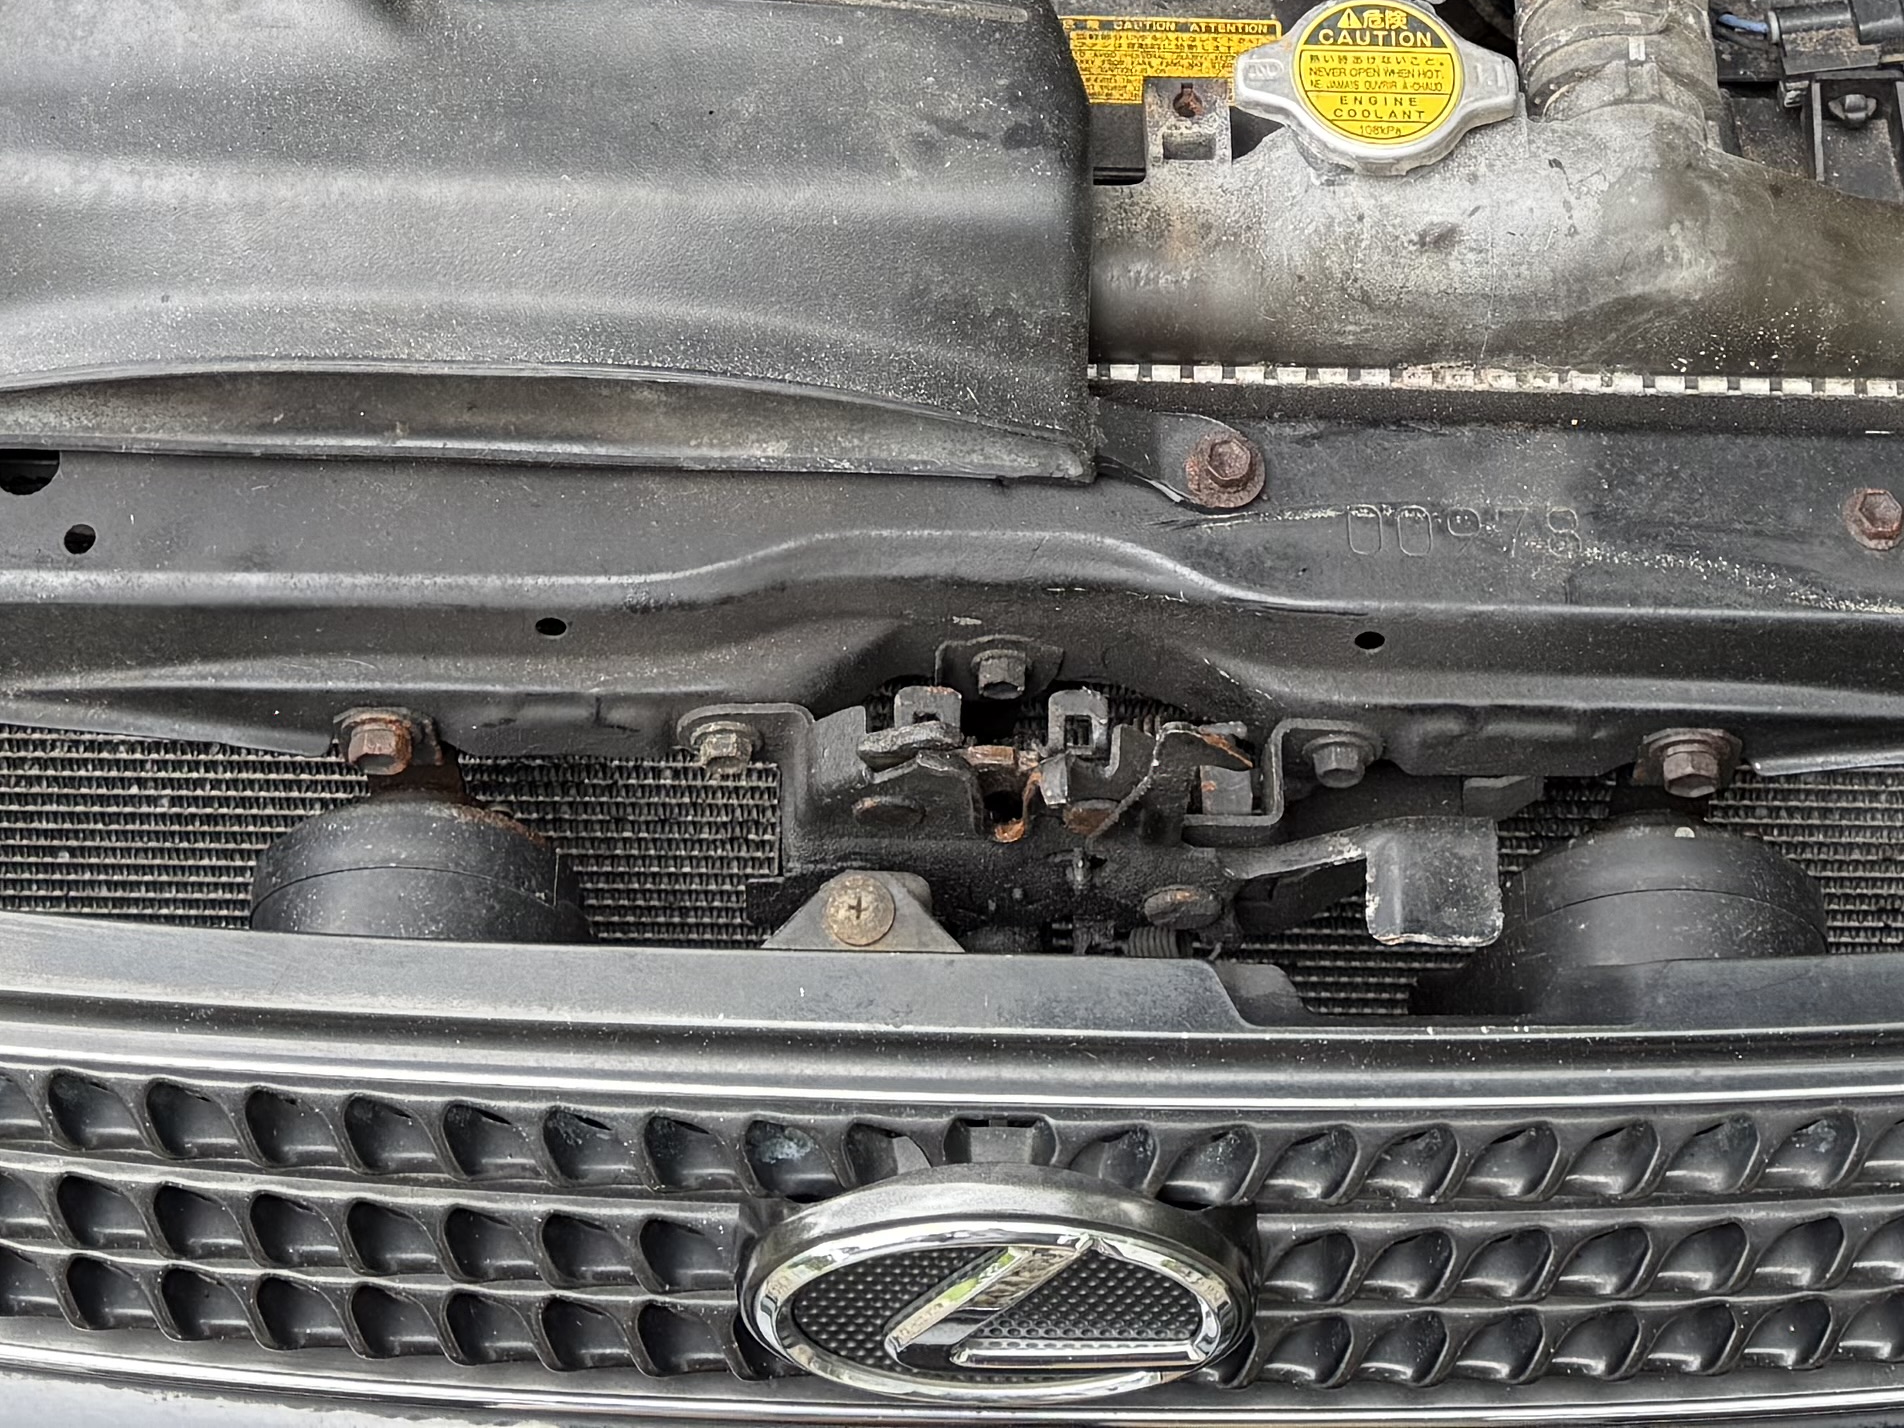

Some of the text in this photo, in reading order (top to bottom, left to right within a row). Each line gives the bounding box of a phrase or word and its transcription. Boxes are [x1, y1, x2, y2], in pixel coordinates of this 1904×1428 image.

[1362, 9, 1408, 30] 危険
[1113, 21, 1176, 32] CAUTION
[1189, 22, 1269, 34] ATTENTION
[1318, 29, 1431, 47] CAUTION
[1309, 67, 1445, 79] NEVER OPEN WHEN HOT.
[1326, 80, 1360, 90] JAMAIS
[1364, 80, 1397, 90] OUVRIR
[1340, 96, 1418, 107] ENGINE
[1333, 108, 1425, 120] COOLANT
